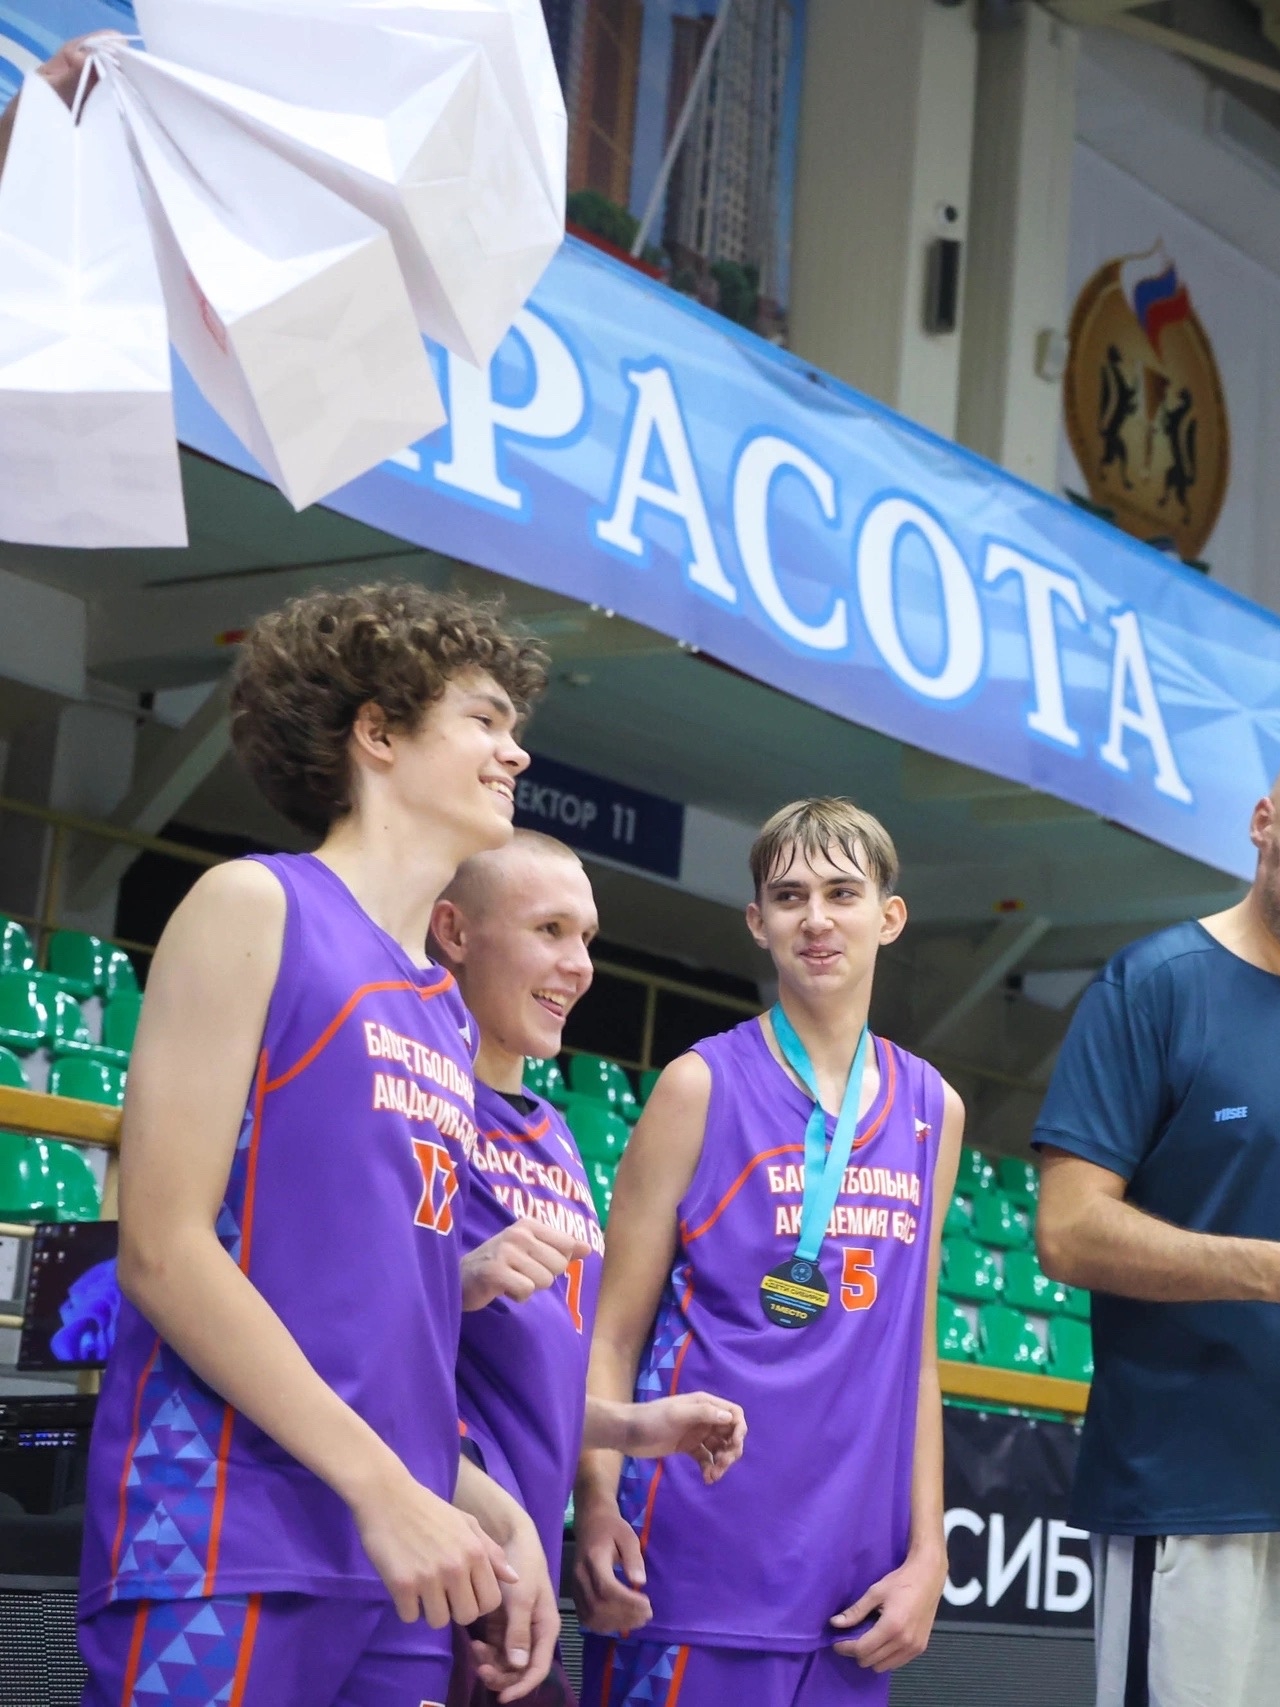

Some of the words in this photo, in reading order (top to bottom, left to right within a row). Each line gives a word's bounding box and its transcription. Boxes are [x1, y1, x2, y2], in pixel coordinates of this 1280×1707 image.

[385, 308, 1193, 804] РАСОТА
[515, 778, 598, 831] ЕКТОР
[612, 802, 636, 845] 11
[775, 1304, 808, 1319] МЕСТО
[840, 1246, 878, 1312] 5
[942, 1506, 1093, 1613] СИБ
